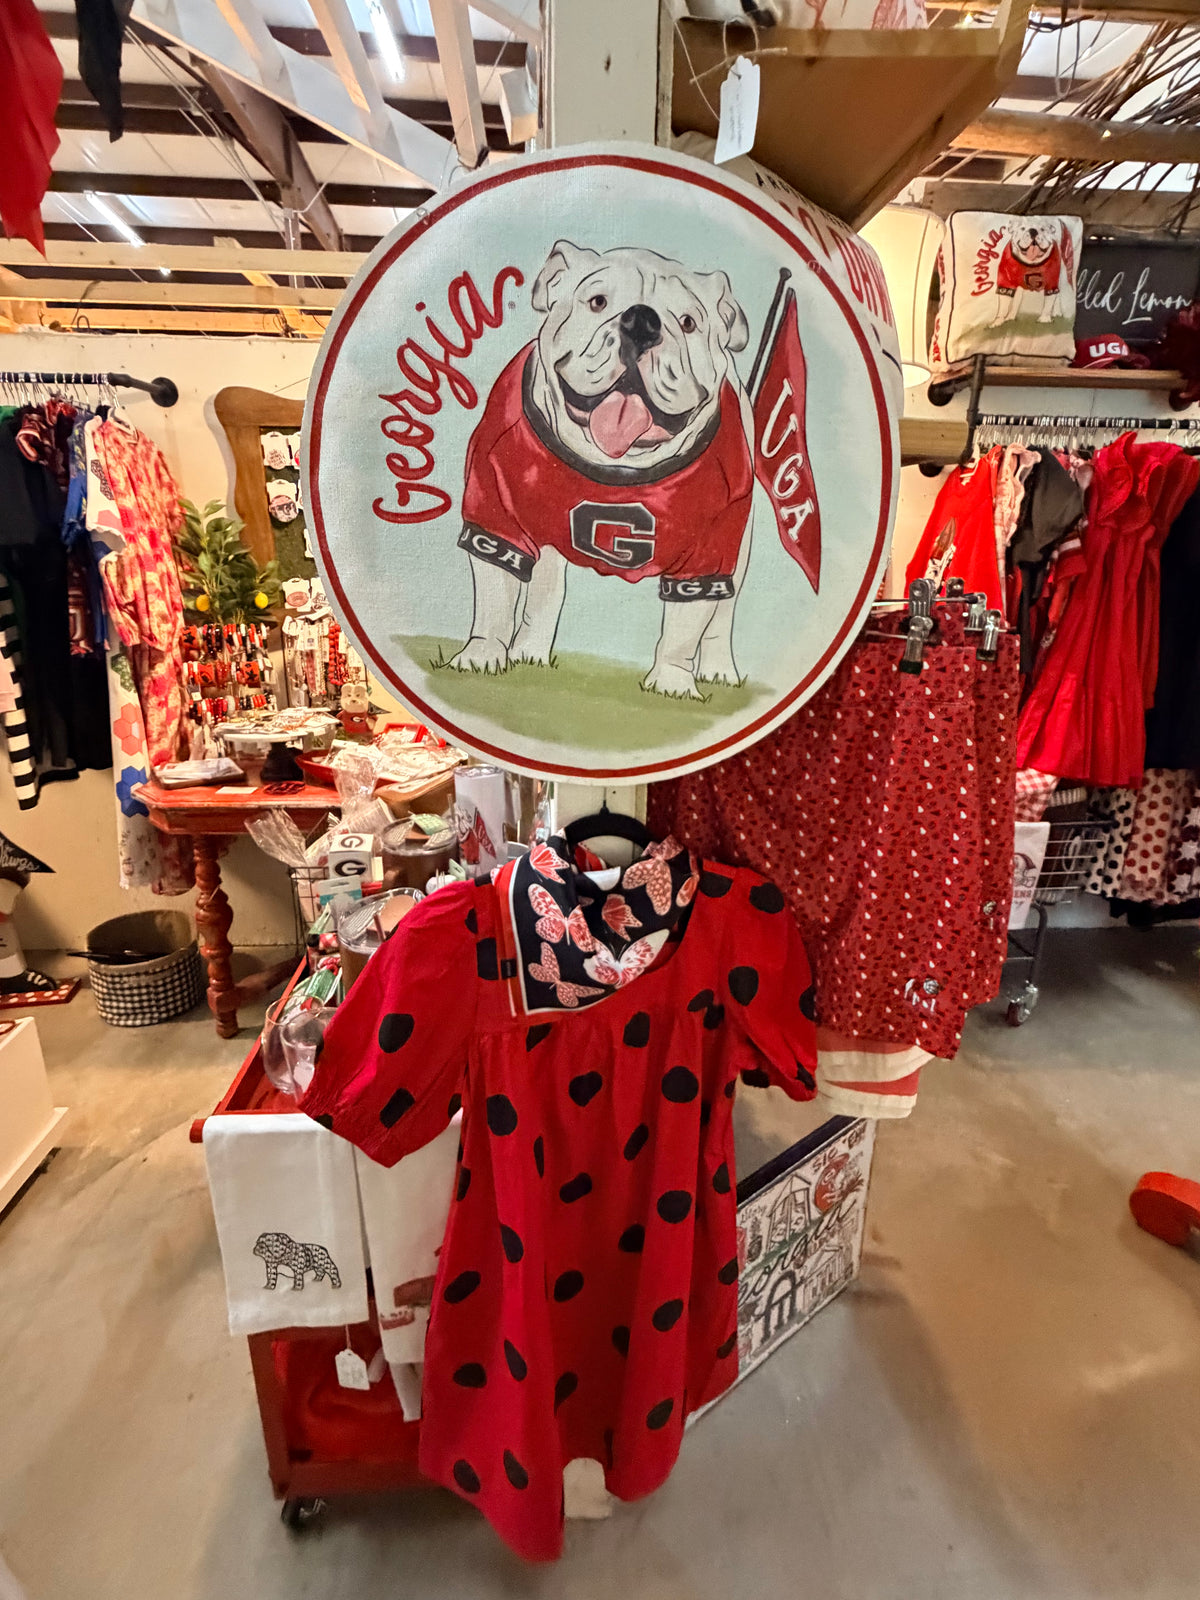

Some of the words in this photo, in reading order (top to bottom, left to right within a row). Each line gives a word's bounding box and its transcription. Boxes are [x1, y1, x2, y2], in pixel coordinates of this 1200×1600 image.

[970, 225, 1007, 297] Georgia
[1121, 266, 1193, 325] Lemon
[372, 266, 524, 524] Georgia
[761, 378, 815, 544] UGA
[569, 500, 656, 569] G
[661, 580, 731, 596] UGA
[334, 859, 368, 877] G
[737, 1199, 857, 1308] eorgia
